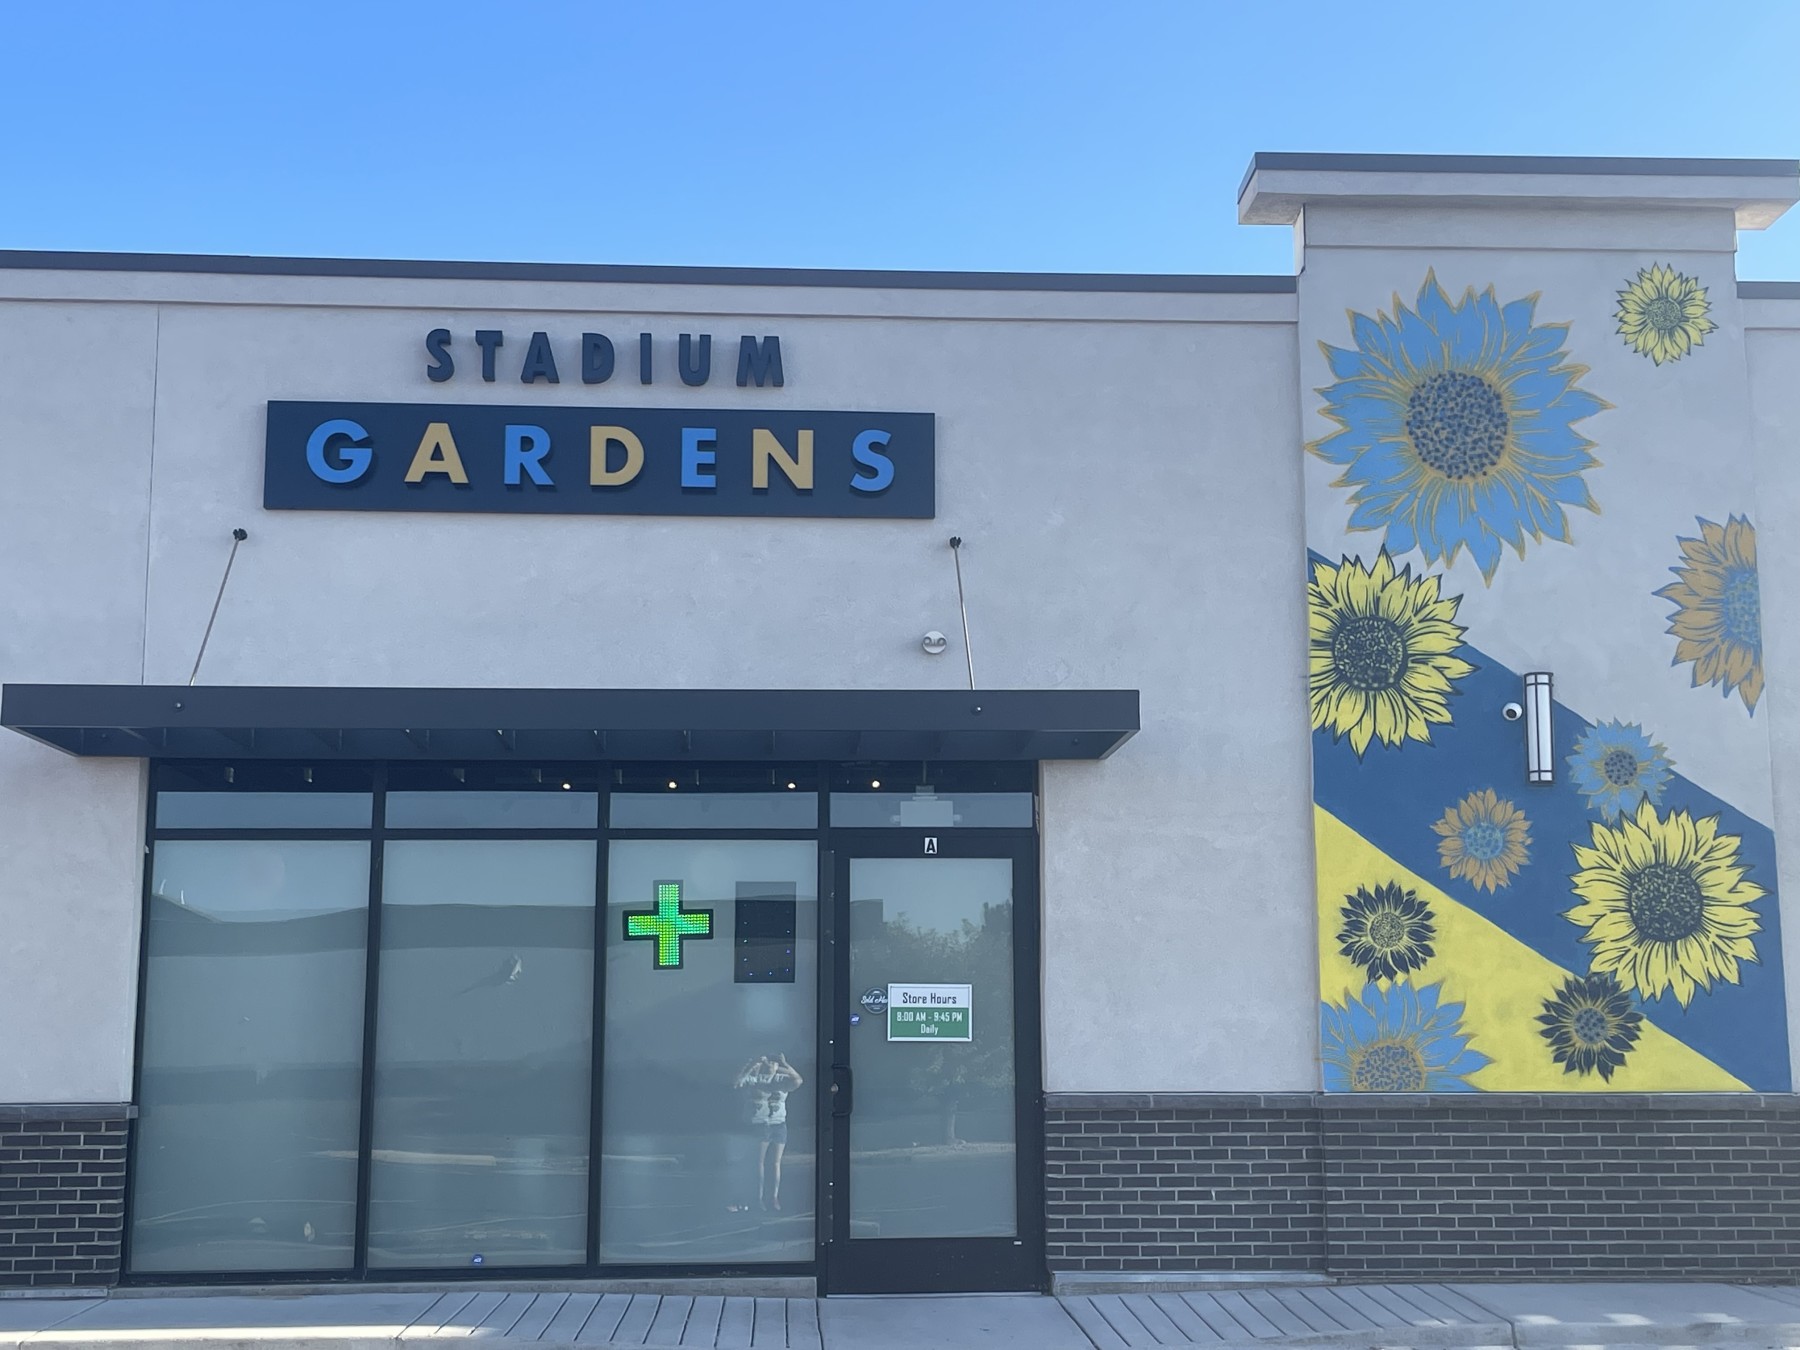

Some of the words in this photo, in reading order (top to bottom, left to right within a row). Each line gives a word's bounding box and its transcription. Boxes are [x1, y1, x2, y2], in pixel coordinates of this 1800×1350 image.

[426, 328, 784, 387] STADIUM
[306, 419, 896, 492] GARDENS
[926, 838, 936, 852] A
[902, 992, 927, 1004] Store
[930, 992, 957, 1004] Hours
[896, 1011, 914, 1022] 8:00
[915, 1011, 926, 1022] AM
[934, 1012, 950, 1022] 9:45
[952, 1012, 963, 1022] PM
[920, 1023, 939, 1035] Daily
